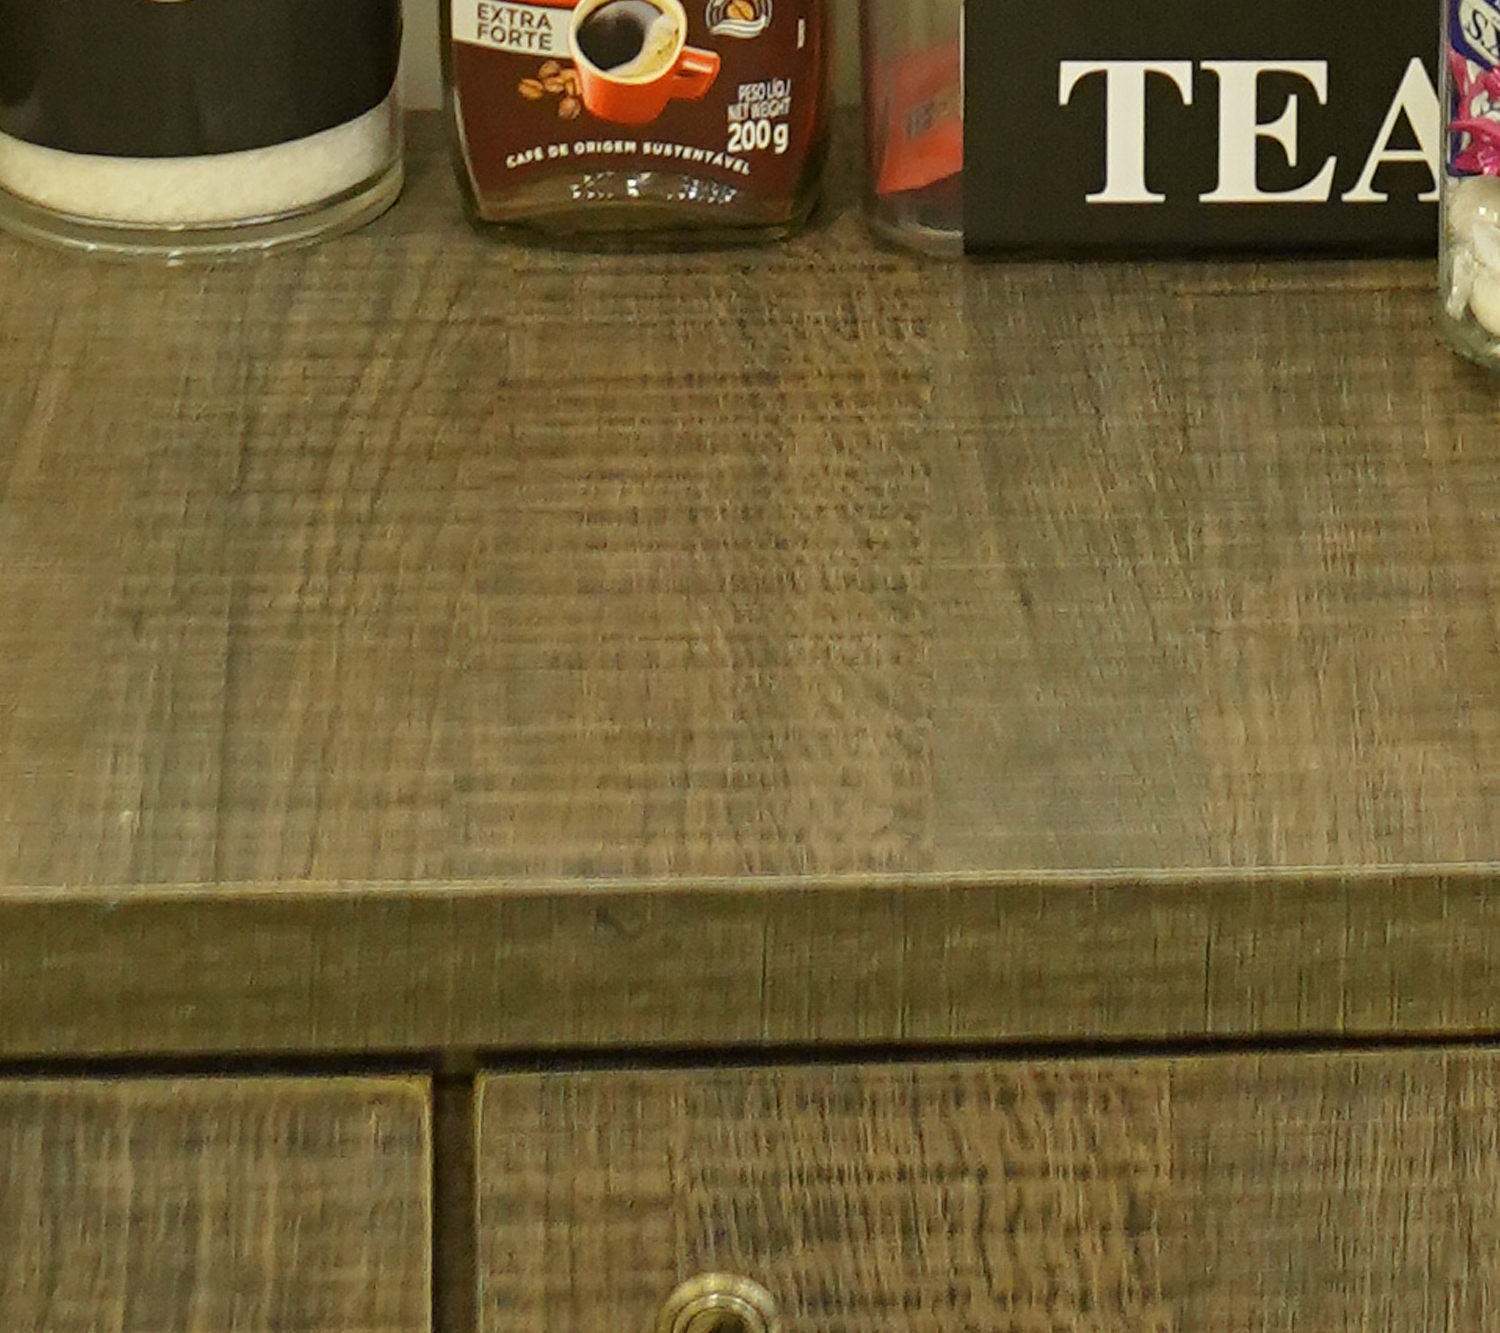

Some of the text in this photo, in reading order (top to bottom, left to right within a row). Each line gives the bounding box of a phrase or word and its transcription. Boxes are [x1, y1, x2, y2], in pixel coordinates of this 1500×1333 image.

[476, 2, 554, 32] EXTRA
[476, 21, 554, 52] FORTE
[1058, 57, 1440, 205] TEA
